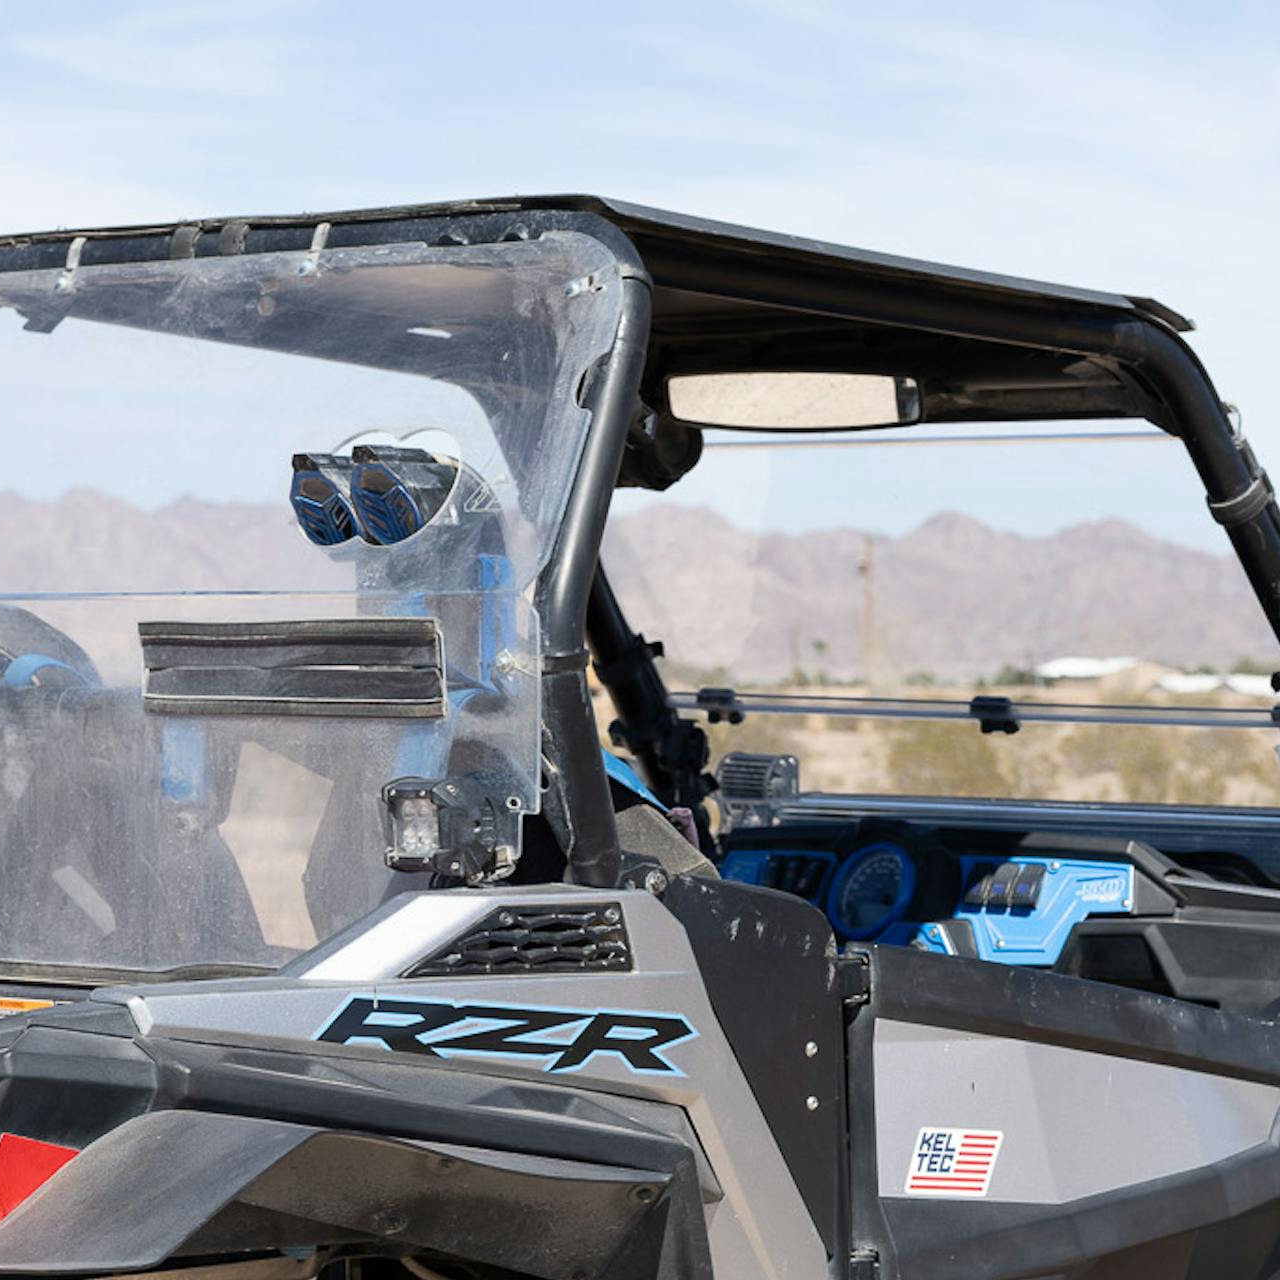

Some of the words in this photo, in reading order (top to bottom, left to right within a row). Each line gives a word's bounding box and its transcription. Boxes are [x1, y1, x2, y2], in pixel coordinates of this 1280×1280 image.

[311, 992, 701, 1077] RZR
[919, 1132, 956, 1152] KEL
[917, 1153, 954, 1173] TEC
